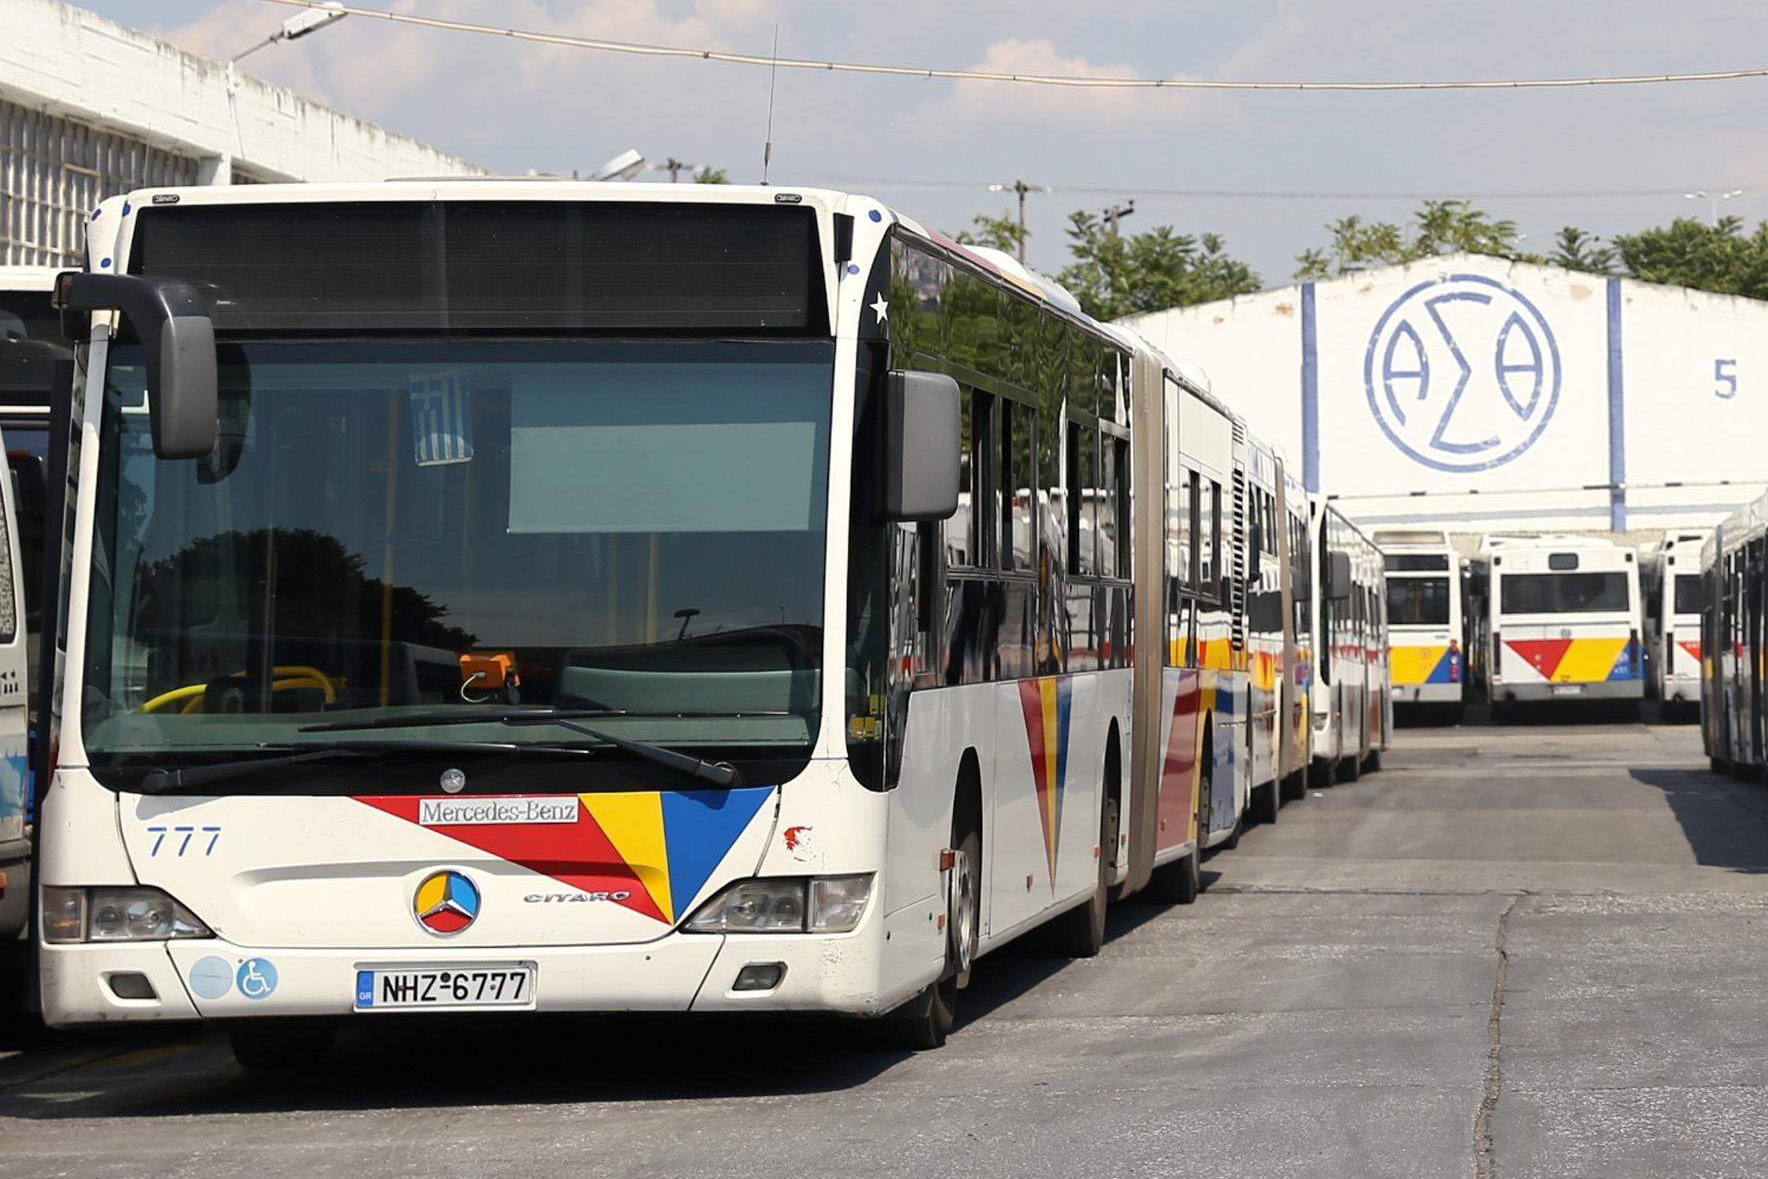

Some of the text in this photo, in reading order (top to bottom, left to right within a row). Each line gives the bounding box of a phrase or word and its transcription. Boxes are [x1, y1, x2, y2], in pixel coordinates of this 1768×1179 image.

[1715, 359, 1737, 399] 5
[422, 800, 576, 822] Mercedes-Benz
[147, 827, 221, 857] 777
[523, 891, 631, 903] CITARO
[358, 992, 372, 1001] GR
